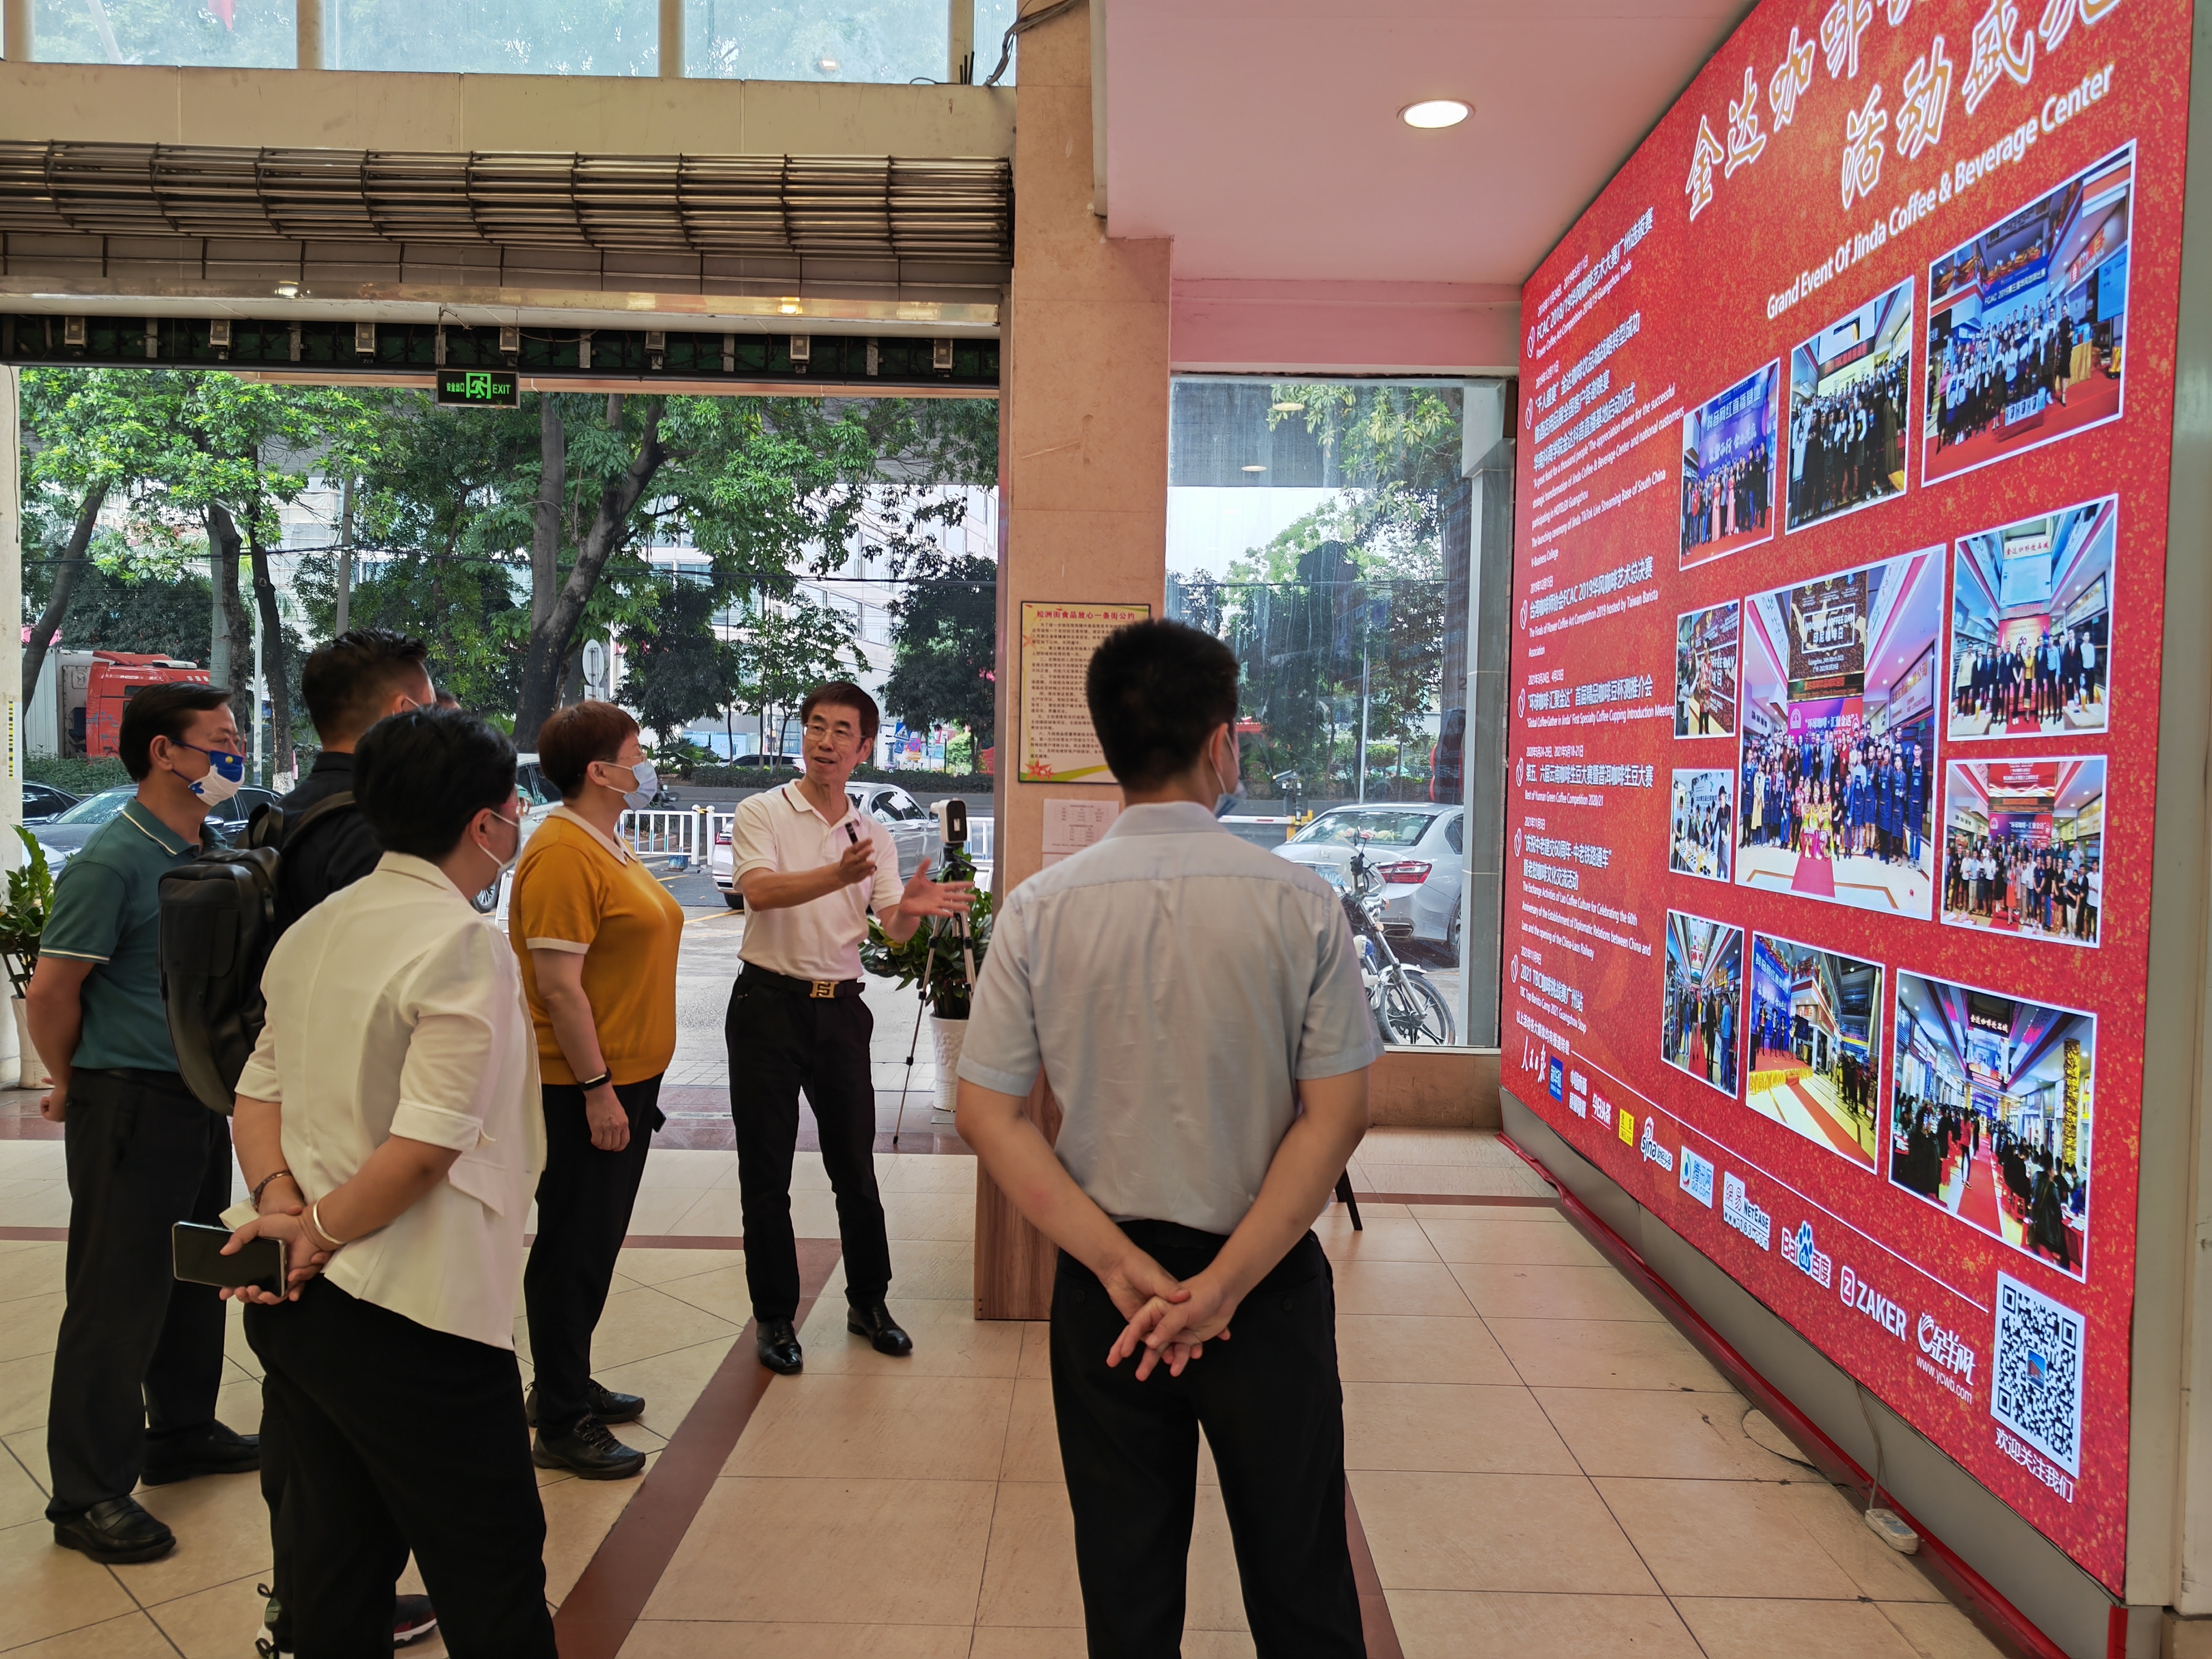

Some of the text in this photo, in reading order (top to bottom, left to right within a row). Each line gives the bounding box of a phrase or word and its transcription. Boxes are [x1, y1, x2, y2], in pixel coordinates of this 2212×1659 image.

[1684, 0, 1911, 220] 金达咖啡
[1767, 65, 2113, 319] Grand Event Of Jinda Coffee & Beverage Center
[1536, 209, 1653, 341] FCAC 2018/19华风咖啡艺术大赛广州选拔赛
[1546, 335, 1556, 350] Coffee
[1561, 309, 1582, 335] Competition
[1582, 292, 1597, 315] 2018/19
[1597, 273, 1620, 299] Guangzhou
[1620, 259, 1631, 277] Trials
[1984, 293, 1998, 306] FCAC
[446, 382, 511, 395] 安全出口 EXIT
[1560, 451, 1576, 471] thousand
[1596, 423, 1620, 448] appreciation
[1620, 413, 1635, 430] dinner
[1651, 382, 1675, 410] successful
[1532, 493, 1545, 509] strategic
[1545, 481, 1568, 501] transformation
[1581, 463, 1593, 478] Coffee
[1597, 450, 1616, 468] Beverage
[1615, 441, 1630, 457] Center
[1639, 420, 1658, 442] national
[1658, 407, 1684, 430] customers
[1532, 511, 1550, 531] participating
[1554, 499, 1568, 516] HOTELEX
[1568, 490, 1588, 508] Guangzhou
[1537, 531, 1552, 545] launching
[1551, 523, 1567, 538] ceremony
[1581, 507, 1593, 522] TikTok
[1601, 494, 1621, 511] Streaming
[1637, 475, 1651, 493] South
[1651, 469, 1666, 484] China
[1531, 548, 1559, 567] V-Business College
[1036, 610, 1135, 620] 松洲街食品放心一条街公约
[1547, 622, 1557, 632] Flower
[1557, 617, 1568, 630] Coffee
[1574, 609, 1596, 625] Competition
[1606, 599, 1620, 614] hosted
[1627, 595, 1642, 608] Taiwan
[1642, 589, 1658, 603] Barista
[1827, 615, 1844, 625] COFFEE
[1528, 645, 1545, 657] Association
[1580, 712, 1596, 726] Specialty
[1596, 710, 1609, 722] Coffee
[1609, 709, 1626, 724] Cupping
[1627, 705, 1654, 719] Introduction
[1654, 700, 1676, 719] Meeting
[1526, 764, 1653, 786] 第五、六届云南咖啡生豆大赛暨普洱咖啡生豆大赛
[1535, 791, 1546, 801] Yunnan
[1555, 792, 1567, 803] Coffee
[1567, 793, 1588, 806] Competition
[1588, 794, 1603, 807] 2020/21
[1528, 882, 1542, 898] Exchange
[1541, 887, 1555, 900] Activities
[1566, 893, 1577, 907] Coffee
[1577, 897, 1590, 911] Culture
[1597, 903, 1619, 923] Celebrating
[1522, 901, 1539, 918] Anniversary
[1547, 909, 1569, 926] Establishment
[1574, 918, 1593, 935] Diplomatic
[1593, 924, 1610, 941] Relations
[1610, 930, 1628, 947] between
[1628, 937, 1641, 953] China
[1539, 929, 1552, 944] opening
[1561, 936, 1580, 953] China-Laos
[1580, 943, 1594, 961] Railway
[1520, 963, 1583, 1011] 2021 TBC咖啡挑战赛广州站
[1559, 1008, 1577, 1027] Guangzhou
[1592, 1092, 1611, 1125] 今日头条
[1641, 1136, 1656, 1159] sina
[1694, 1160, 1711, 1190] 腾讯网
[1812, 1253, 1829, 1284] 百度
[1856, 1280, 1906, 1342] ZAKER
[1916, 1355, 1972, 1405] www.ycwb.com
[1995, 1427, 2073, 1503] 欢迎关注我们
